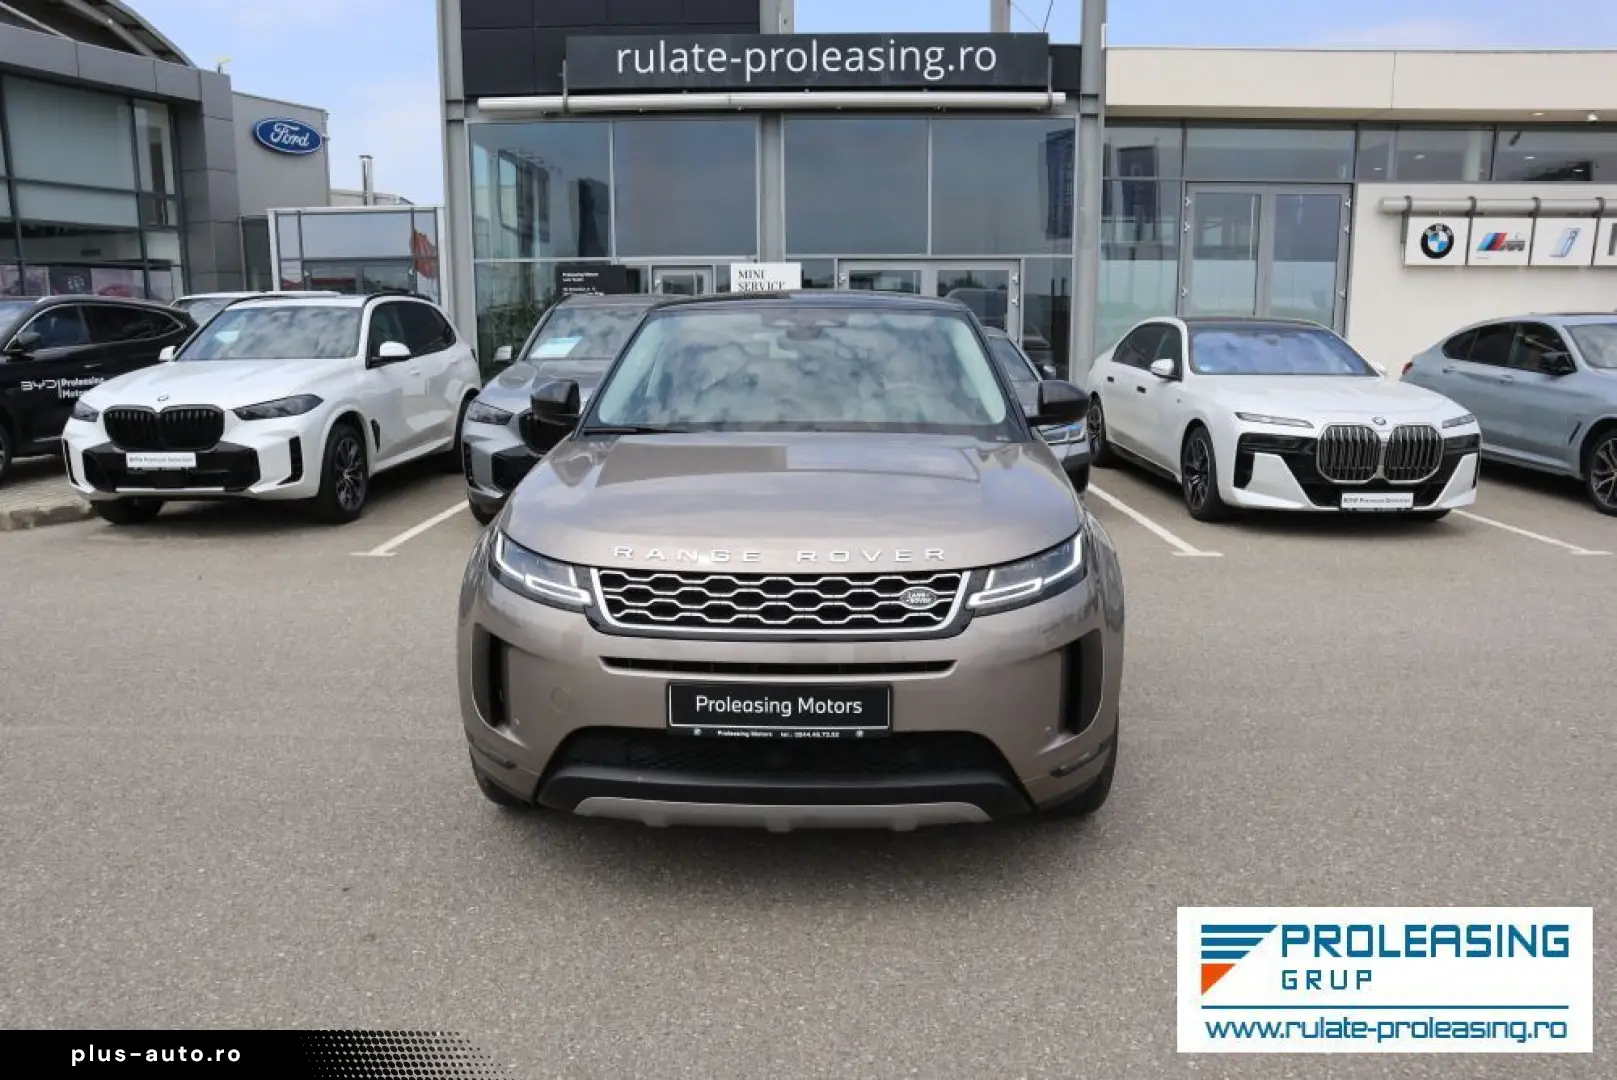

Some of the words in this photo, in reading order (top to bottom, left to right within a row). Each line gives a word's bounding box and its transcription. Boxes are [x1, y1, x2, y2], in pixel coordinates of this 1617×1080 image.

[616, 39, 998, 82] rulate-proleasing.ro
[270, 122, 310, 147] Ford
[738, 269, 764, 279] MINI
[614, 547, 761, 563] RANGE
[796, 547, 945, 563] ROVER
[696, 695, 791, 717] Proleasing
[798, 697, 863, 714] Motors
